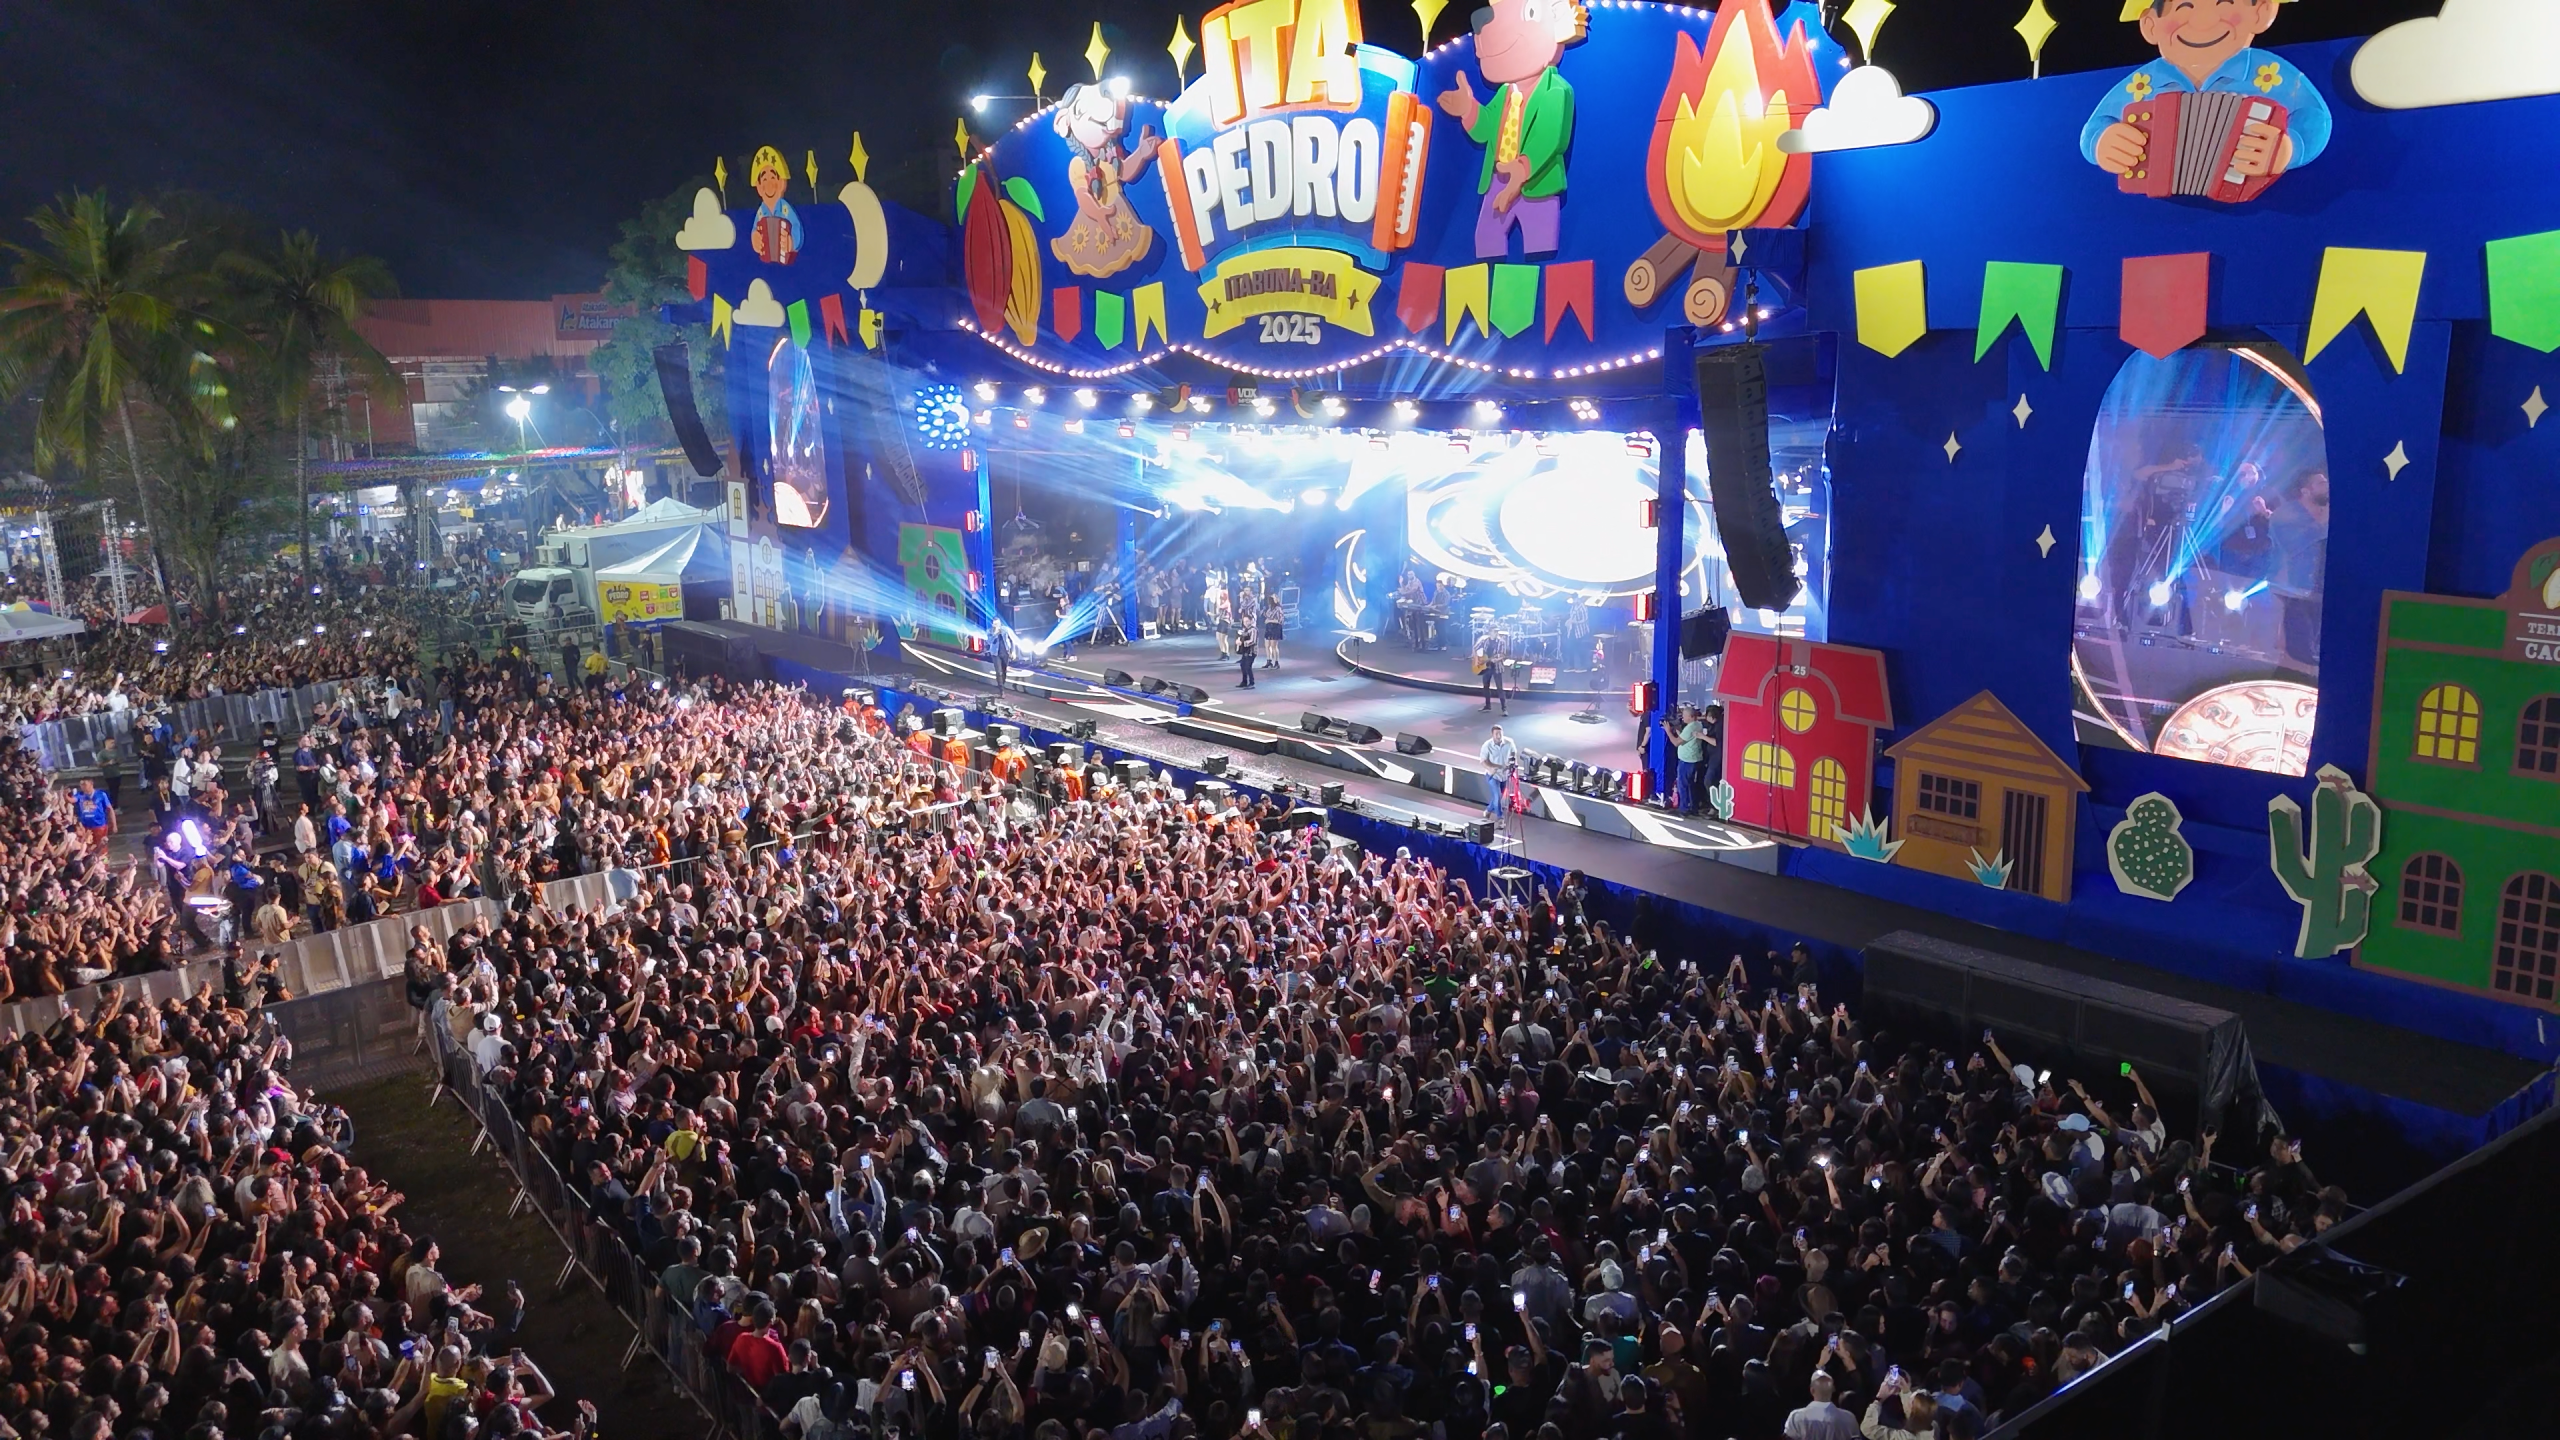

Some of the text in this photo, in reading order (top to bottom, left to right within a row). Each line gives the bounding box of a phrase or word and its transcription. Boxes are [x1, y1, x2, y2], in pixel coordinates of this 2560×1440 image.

[1203, 0, 1359, 122] ITA
[1183, 116, 1380, 246] PEDRO
[1224, 268, 1337, 302] ITABUNA-BA
[1259, 314, 1321, 345] 2025
[1238, 388, 1257, 398] VOX
[1794, 665, 1806, 676] 25
